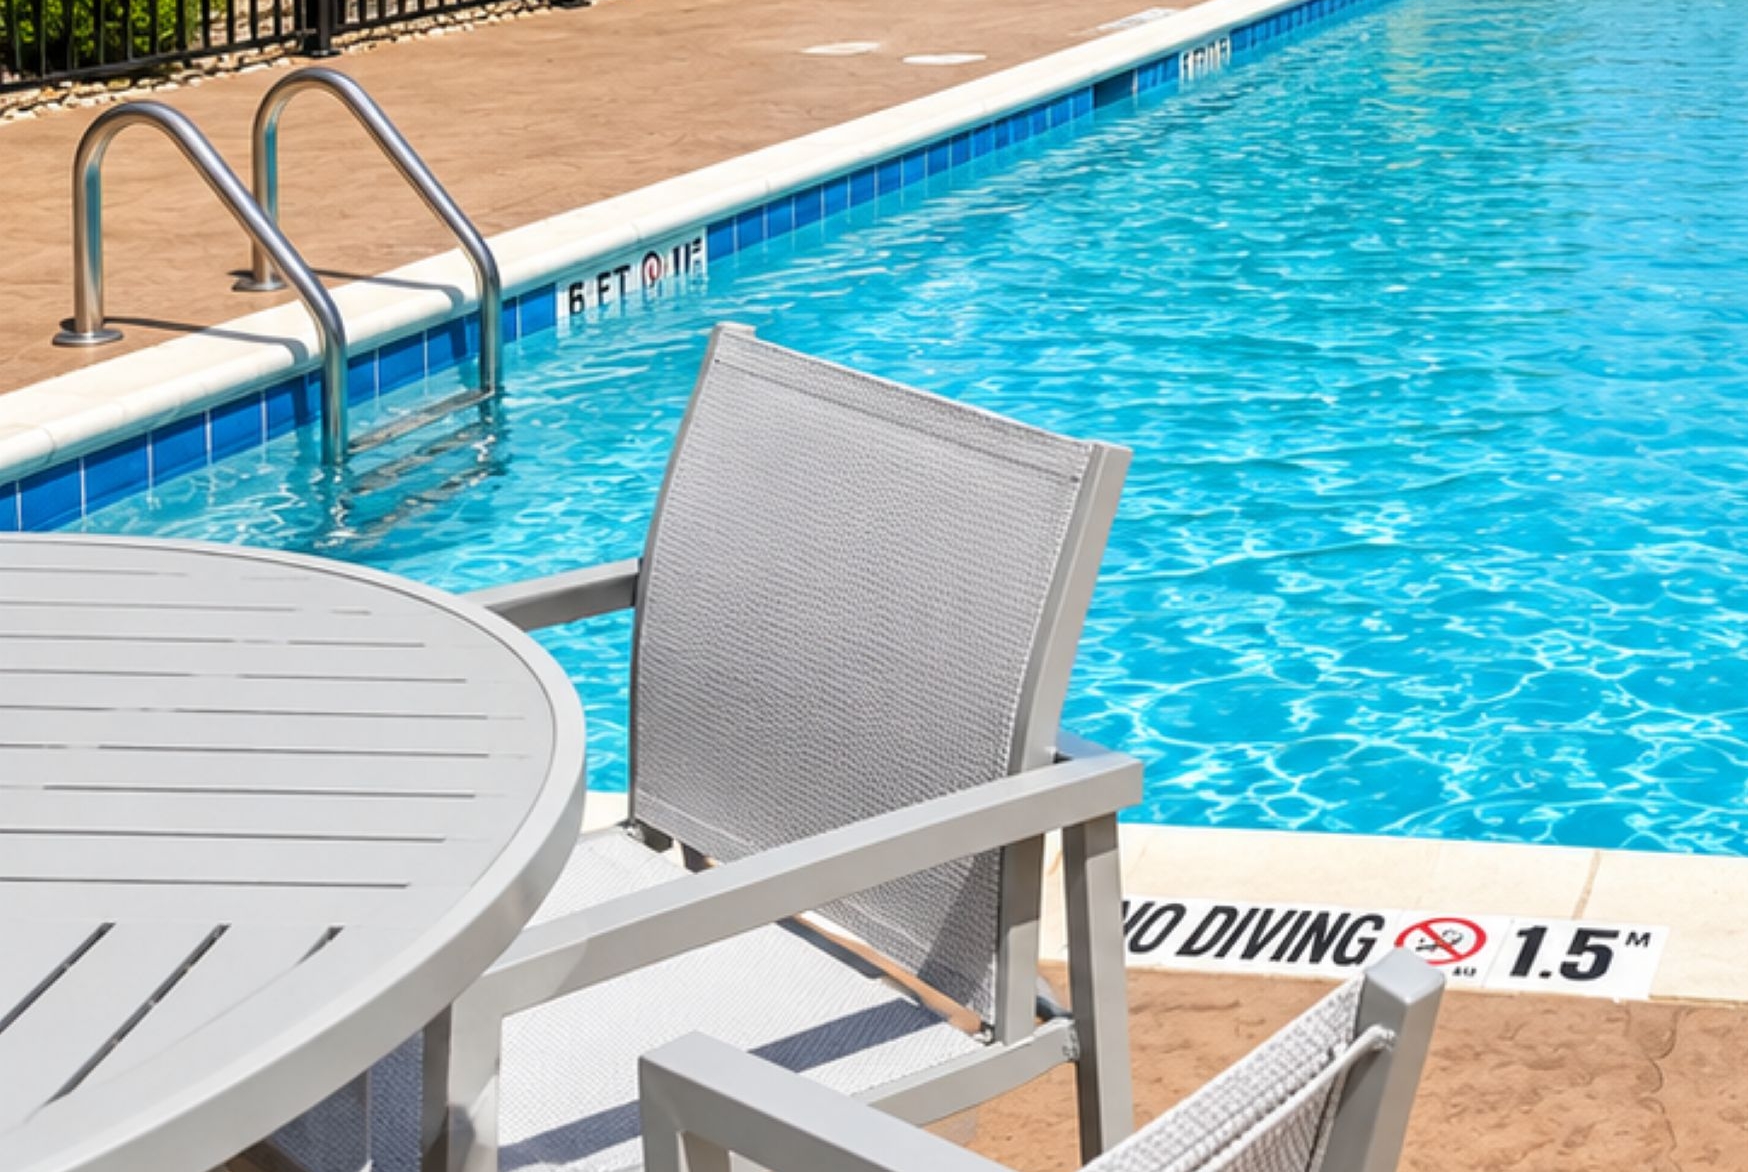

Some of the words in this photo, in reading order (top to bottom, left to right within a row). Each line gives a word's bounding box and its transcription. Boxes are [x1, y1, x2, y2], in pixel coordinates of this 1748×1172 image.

[569, 280, 585, 315] 6
[1175, 905, 1386, 967] DIVING
[1509, 925, 1620, 981] 1.5
